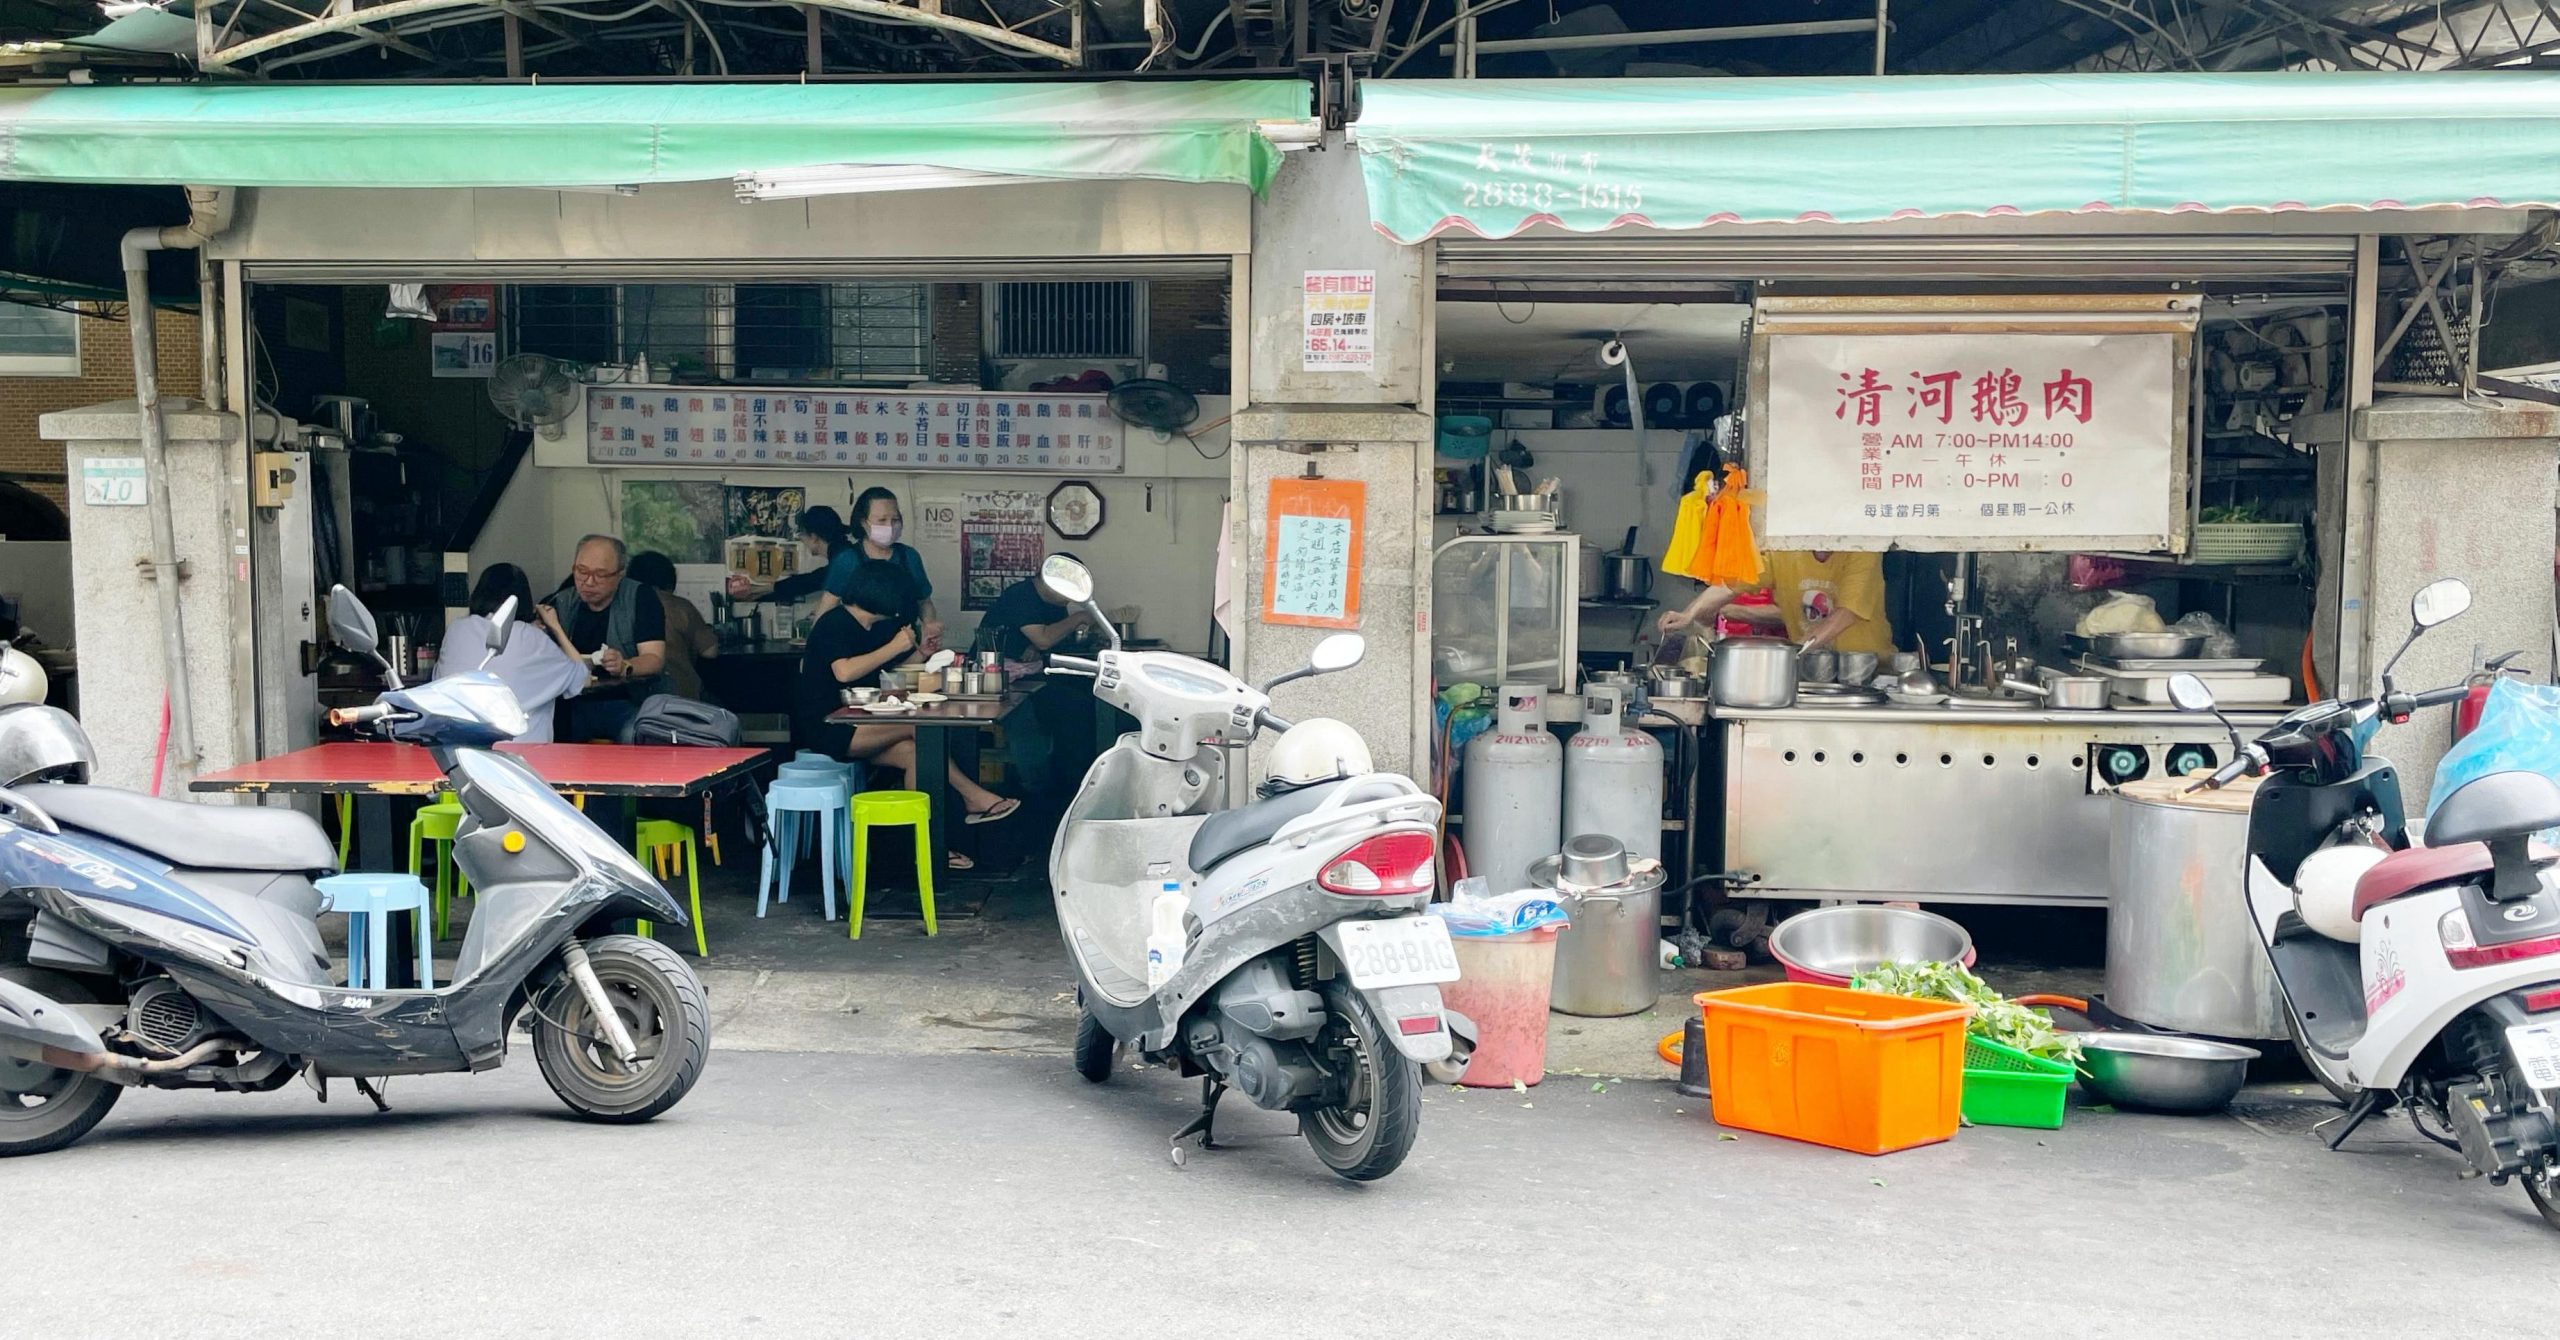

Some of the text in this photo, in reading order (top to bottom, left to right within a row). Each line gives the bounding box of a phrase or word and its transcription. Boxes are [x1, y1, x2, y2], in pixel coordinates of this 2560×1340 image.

[1462, 181, 1643, 209] 2888-1515
[471, 343, 494, 364] 16
[1834, 366, 2094, 428] 清河鵝肉
[753, 398, 768, 443] 甜不辣
[875, 401, 888, 447] 米粉
[896, 401, 909, 447] 冬粉
[915, 401, 929, 447] 米苔目
[1891, 433, 1923, 448] AM
[714, 449, 726, 459] 40
[754, 449, 766, 459] 40
[836, 451, 848, 461] 40
[876, 451, 888, 461] 40
[896, 452, 908, 462] 40
[916, 452, 928, 462] 40
[938, 453, 949, 463] 40
[956, 452, 969, 463] 40
[996, 454, 1010, 465] 20
[1016, 454, 1029, 465] 25
[1038, 454, 1050, 465] 40
[1076, 455, 1090, 465] 40
[1860, 431, 1884, 491] 營業時間
[1891, 473, 1923, 488] PM
[1863, 501, 2077, 519] 每逢當月第 個星期一公休
